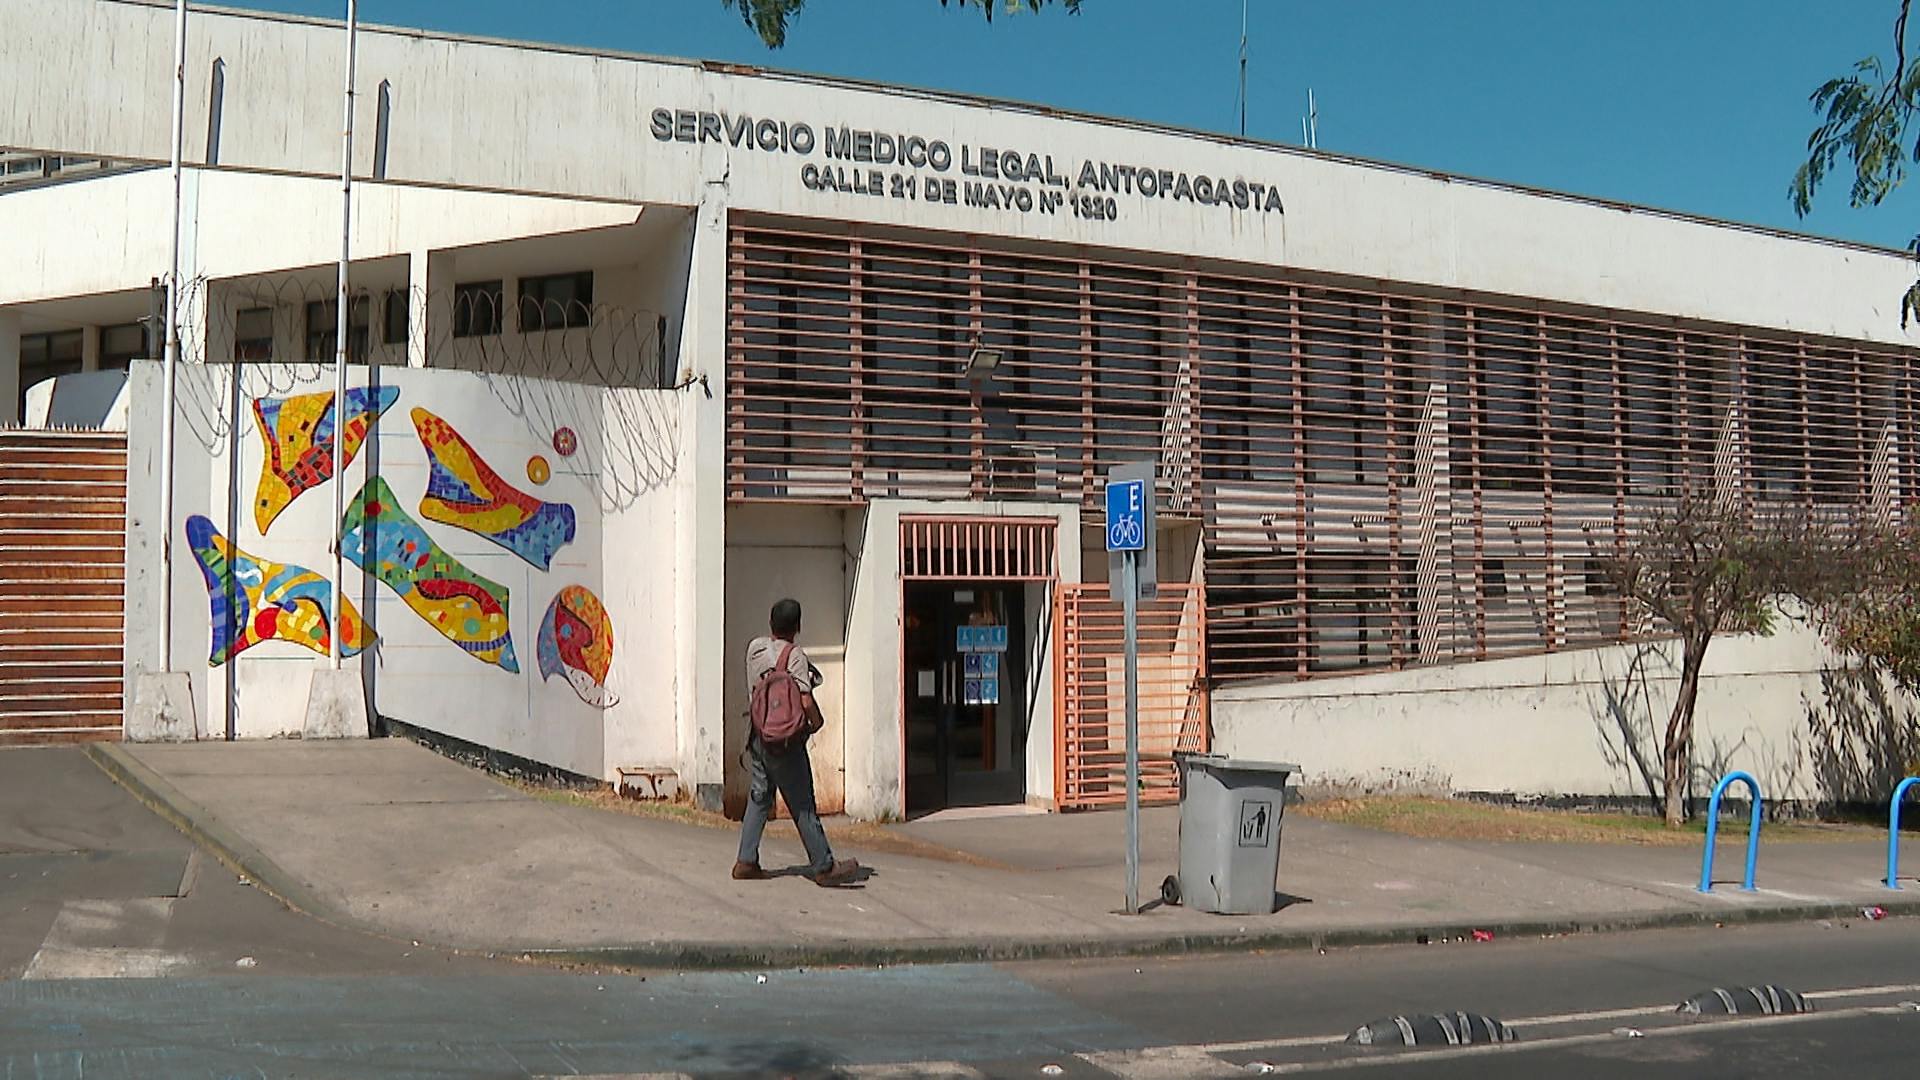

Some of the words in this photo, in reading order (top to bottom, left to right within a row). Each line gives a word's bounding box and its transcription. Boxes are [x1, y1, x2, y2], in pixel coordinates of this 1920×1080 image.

[650, 107, 815, 155] SERVICIO
[824, 125, 951, 172] MEDICO
[1078, 159, 1284, 215] ANTOFAGASTA
[801, 163, 884, 196] CALLE
[890, 173, 916, 201] 21
[924, 176, 957, 205] DE
[963, 181, 1033, 212] MAYO
[1070, 193, 1117, 222] 1320
[1130, 484, 1139, 511] E
